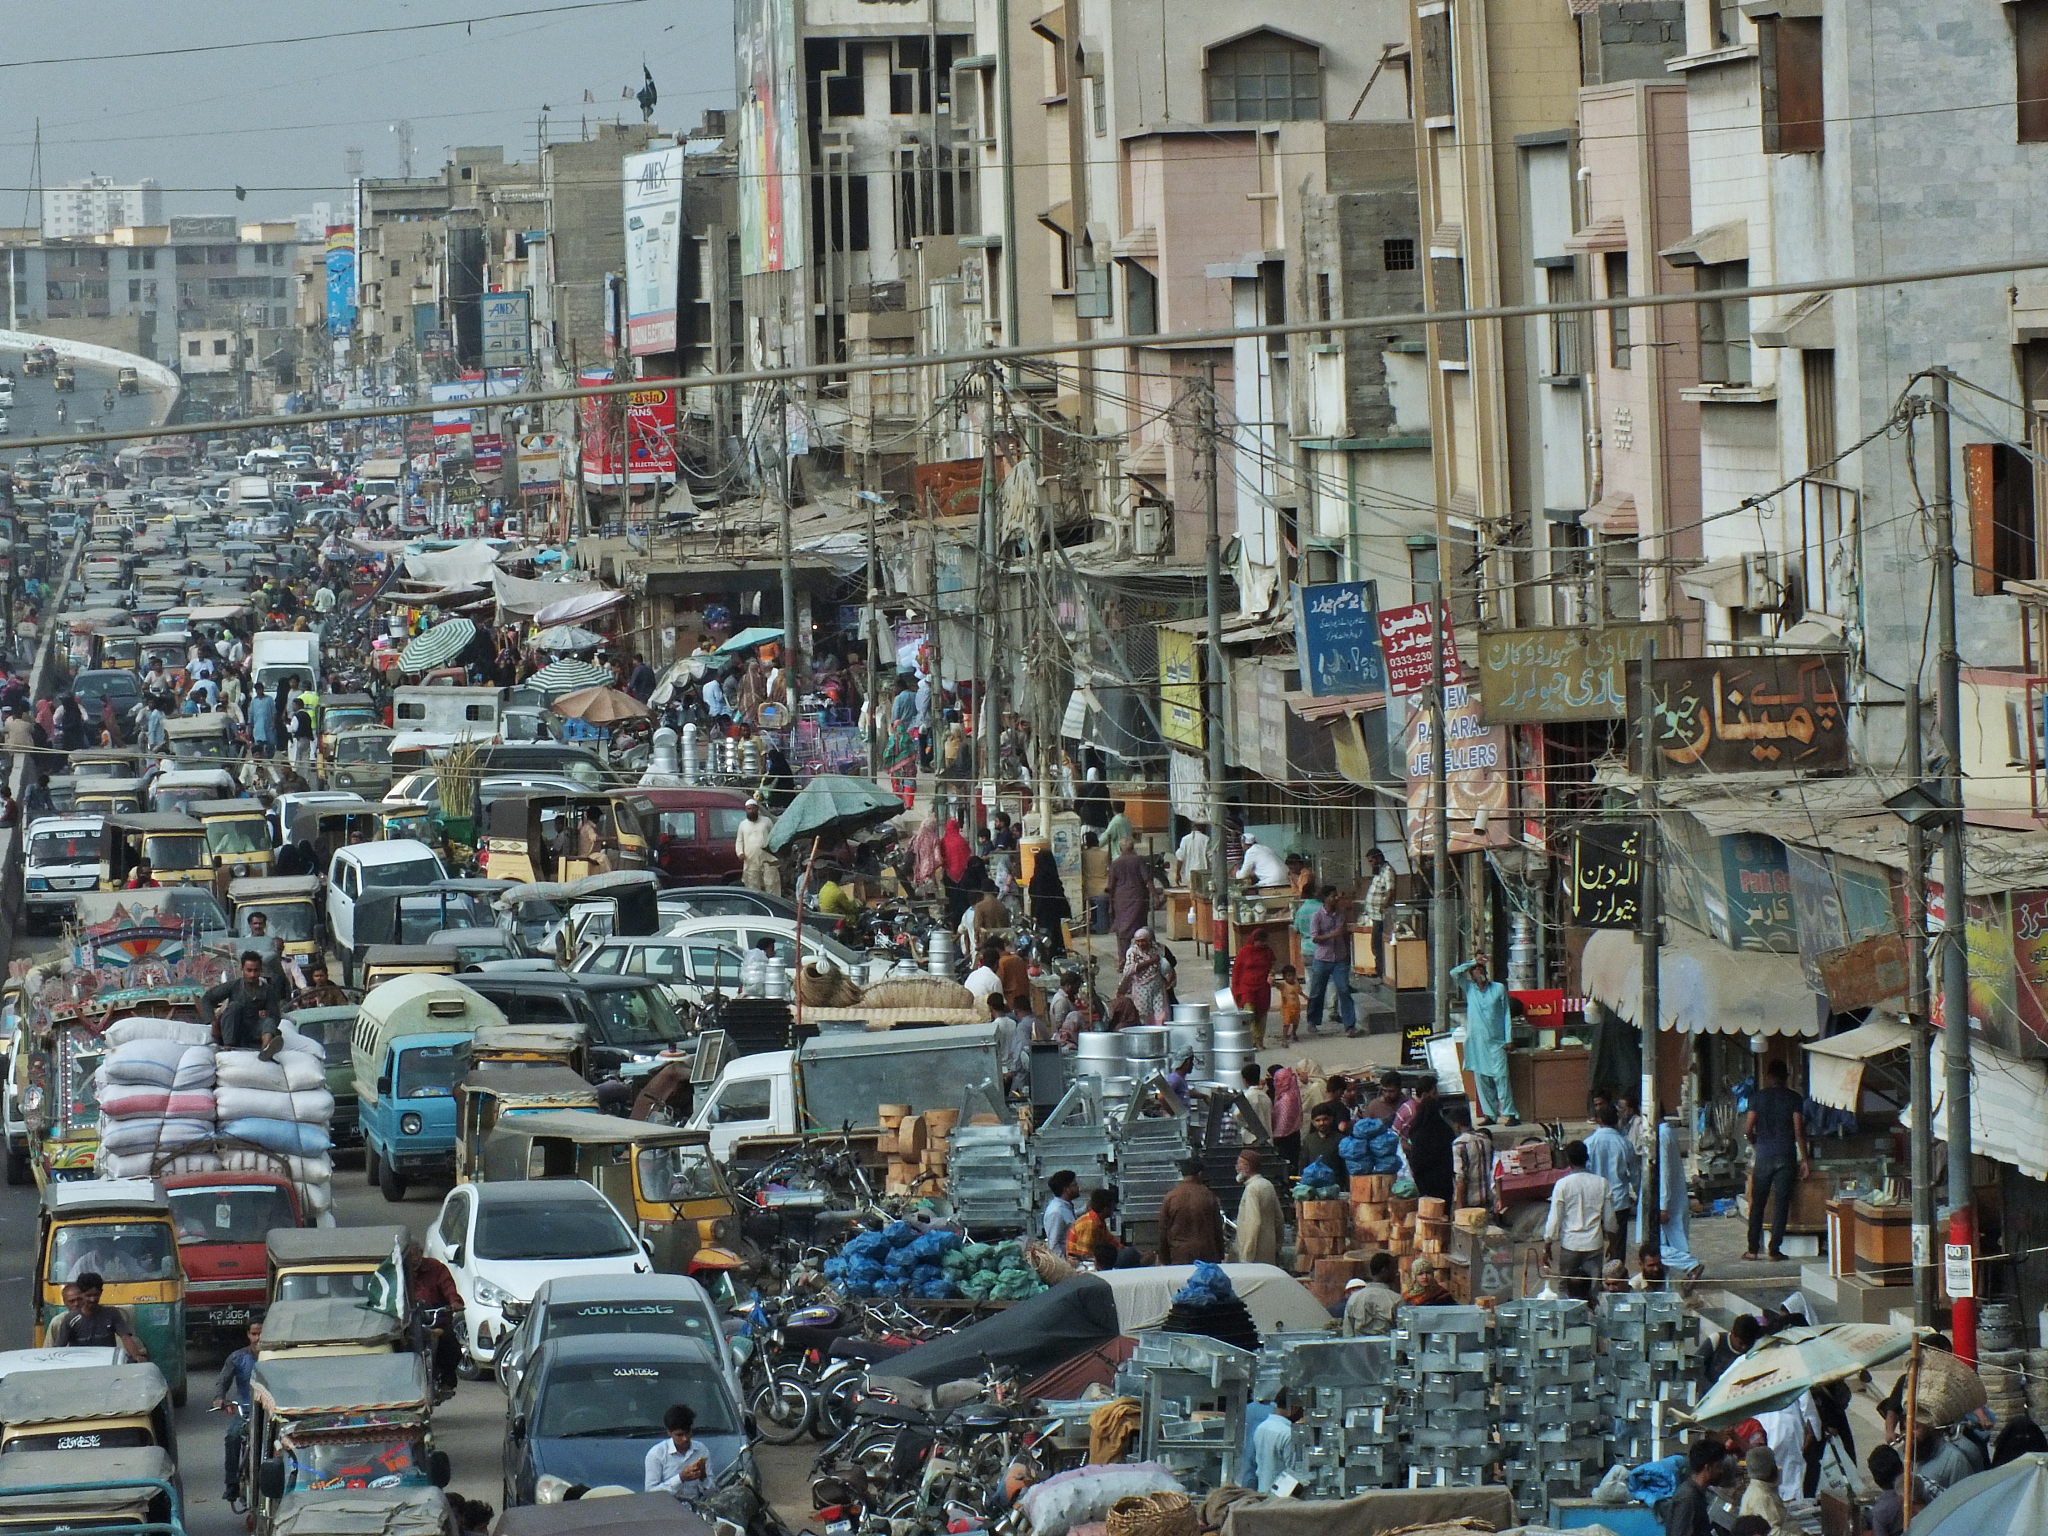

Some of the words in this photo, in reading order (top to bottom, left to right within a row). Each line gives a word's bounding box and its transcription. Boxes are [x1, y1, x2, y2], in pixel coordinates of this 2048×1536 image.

[636, 153, 670, 196] ANEX
[488, 300, 520, 317] ANEX
[1390, 647, 1454, 667] 0333-23043
[1391, 658, 1457, 679] 0315-23043
[1444, 684, 1470, 710] EW
[1411, 743, 1498, 777] JEELLERS
[1622, 831, 1638, 855] نیو
[1580, 862, 1616, 890] دین
[1739, 868, 1773, 894] Pak
[1591, 892, 1637, 923] جیولرز
